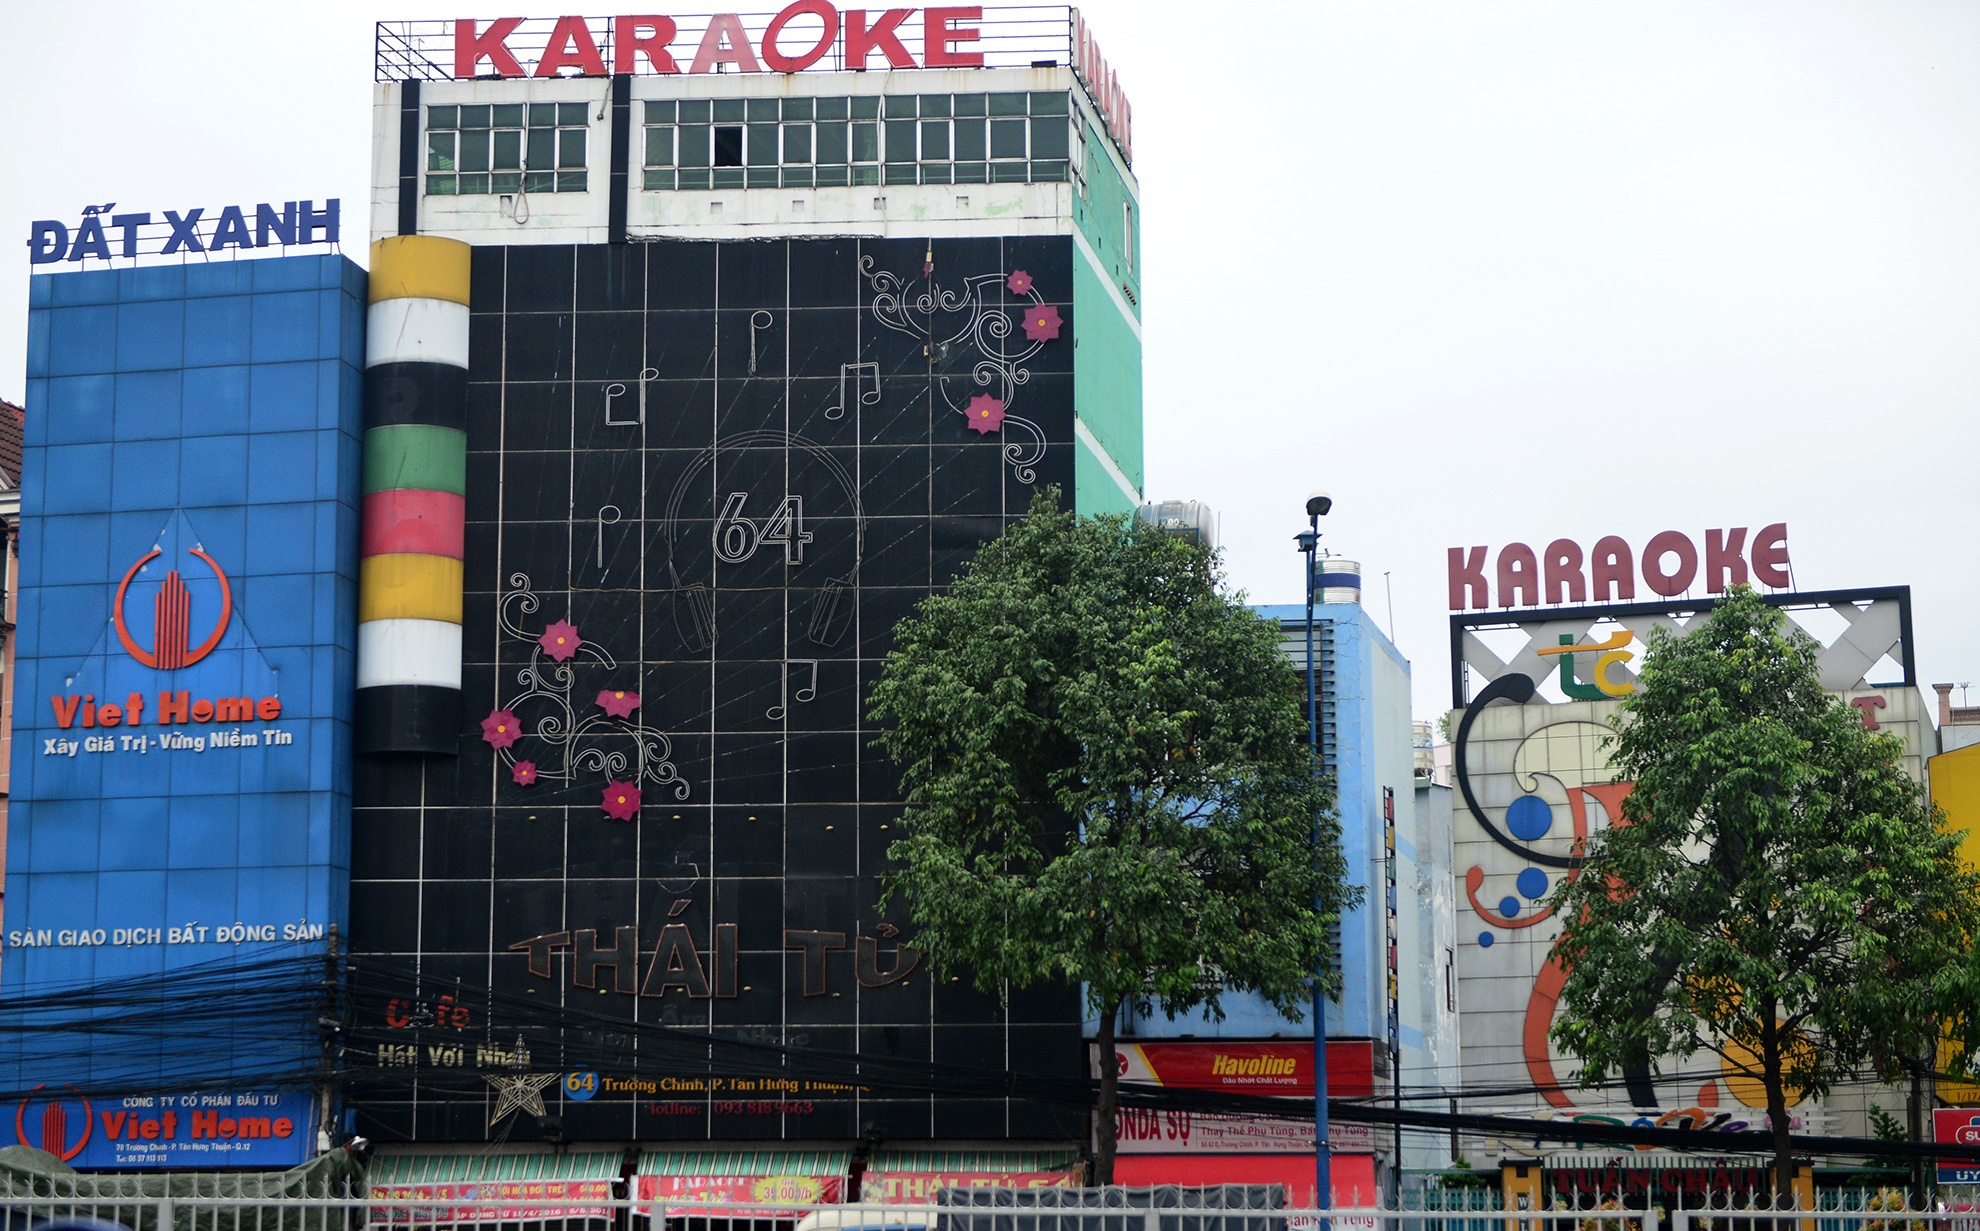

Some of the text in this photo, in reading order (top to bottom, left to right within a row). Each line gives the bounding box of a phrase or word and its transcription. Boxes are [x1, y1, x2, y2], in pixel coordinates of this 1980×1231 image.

[454, 0, 985, 79] KARAOKE
[27, 198, 340, 264] ĐẤT XANH
[713, 492, 813, 565] 64
[1447, 522, 1790, 610] KARAOKE
[51, 690, 282, 728] Viet Home
[44, 738, 79, 757] Xây
[84, 736, 115, 752] Giá
[210, 728, 257, 747] Niềm
[263, 729, 292, 745] Tin
[9, 918, 323, 948] SÀN GIAO DỊCH BẤT ĐỘNG SẢN
[509, 899, 738, 998] THÁI
[1212, 1054, 1297, 1075] Havoline
[566, 1071, 595, 1092] 64
[1957, 1092, 1980, 1101] 1/17
[160, 1096, 175, 1107] TY
[101, 1109, 293, 1140] Viet Home
[1115, 1107, 1161, 1140] ONDA
